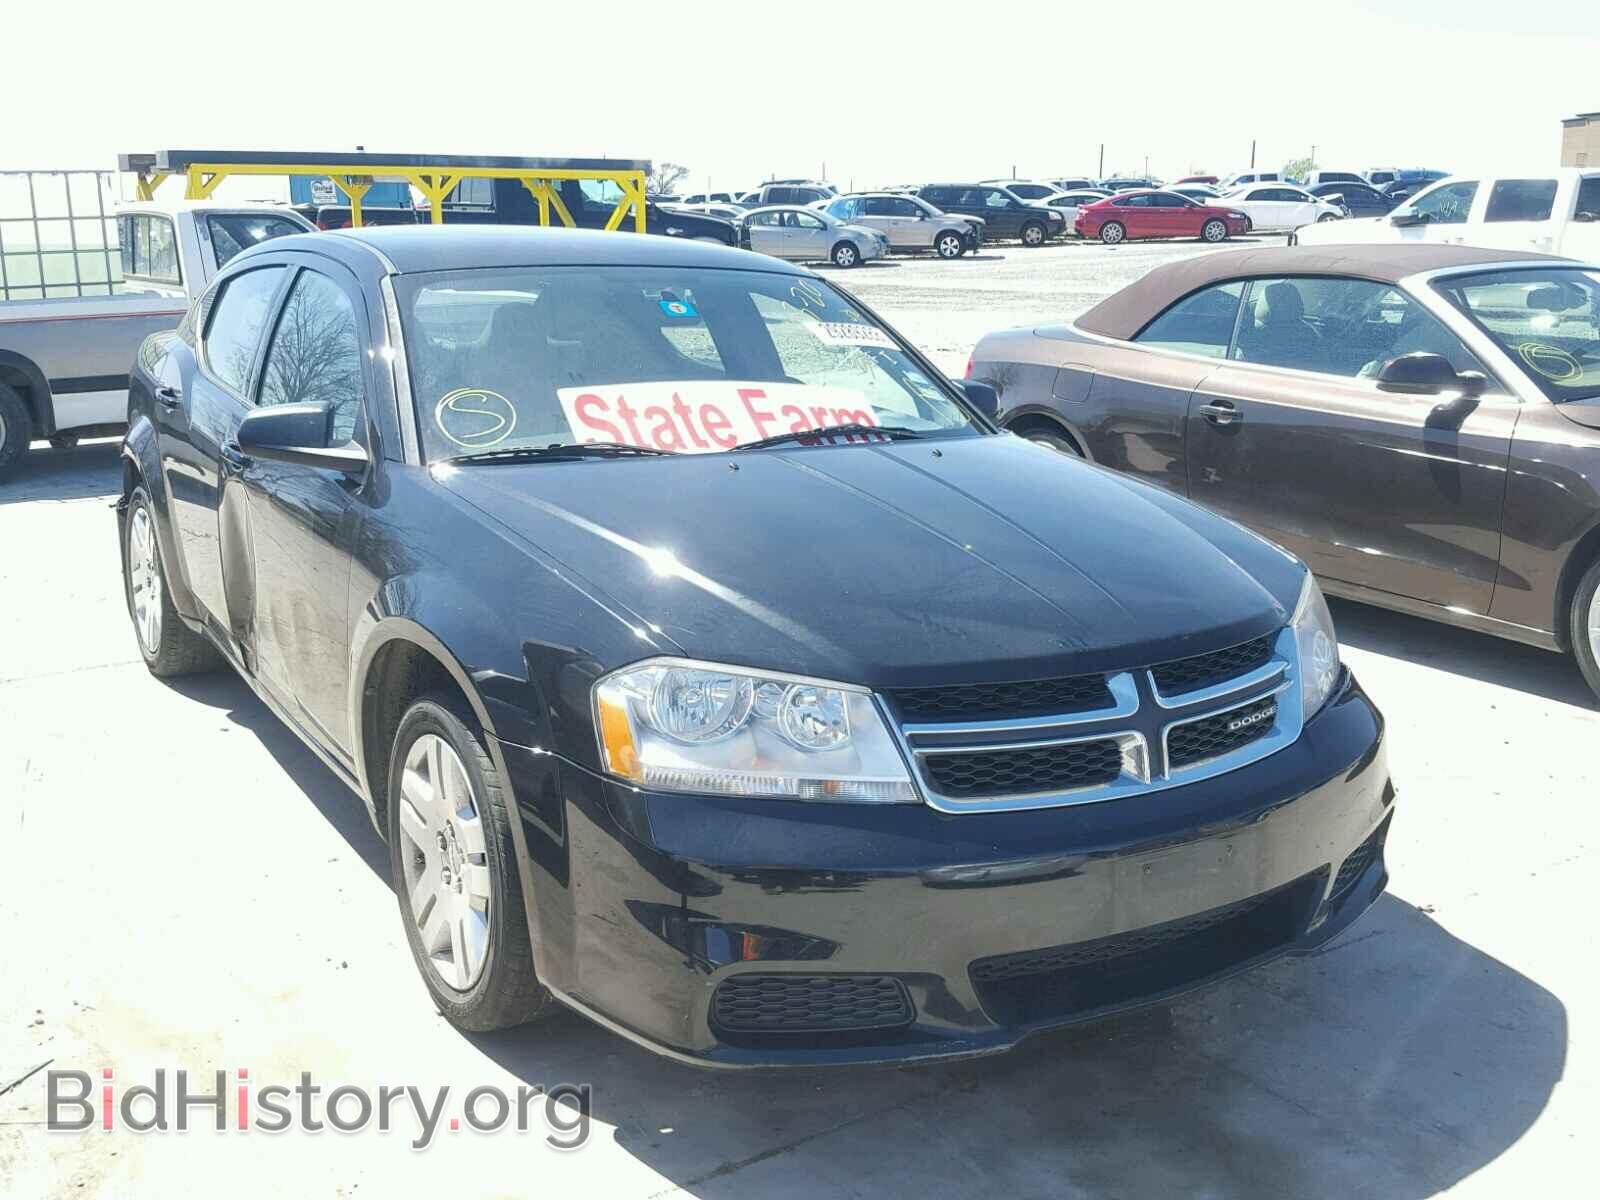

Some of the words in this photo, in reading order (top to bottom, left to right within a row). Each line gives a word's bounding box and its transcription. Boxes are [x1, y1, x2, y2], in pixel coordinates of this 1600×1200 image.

[574, 391, 738, 452] State
[736, 388, 890, 446] Farm
[1228, 705, 1276, 731] DODGE
